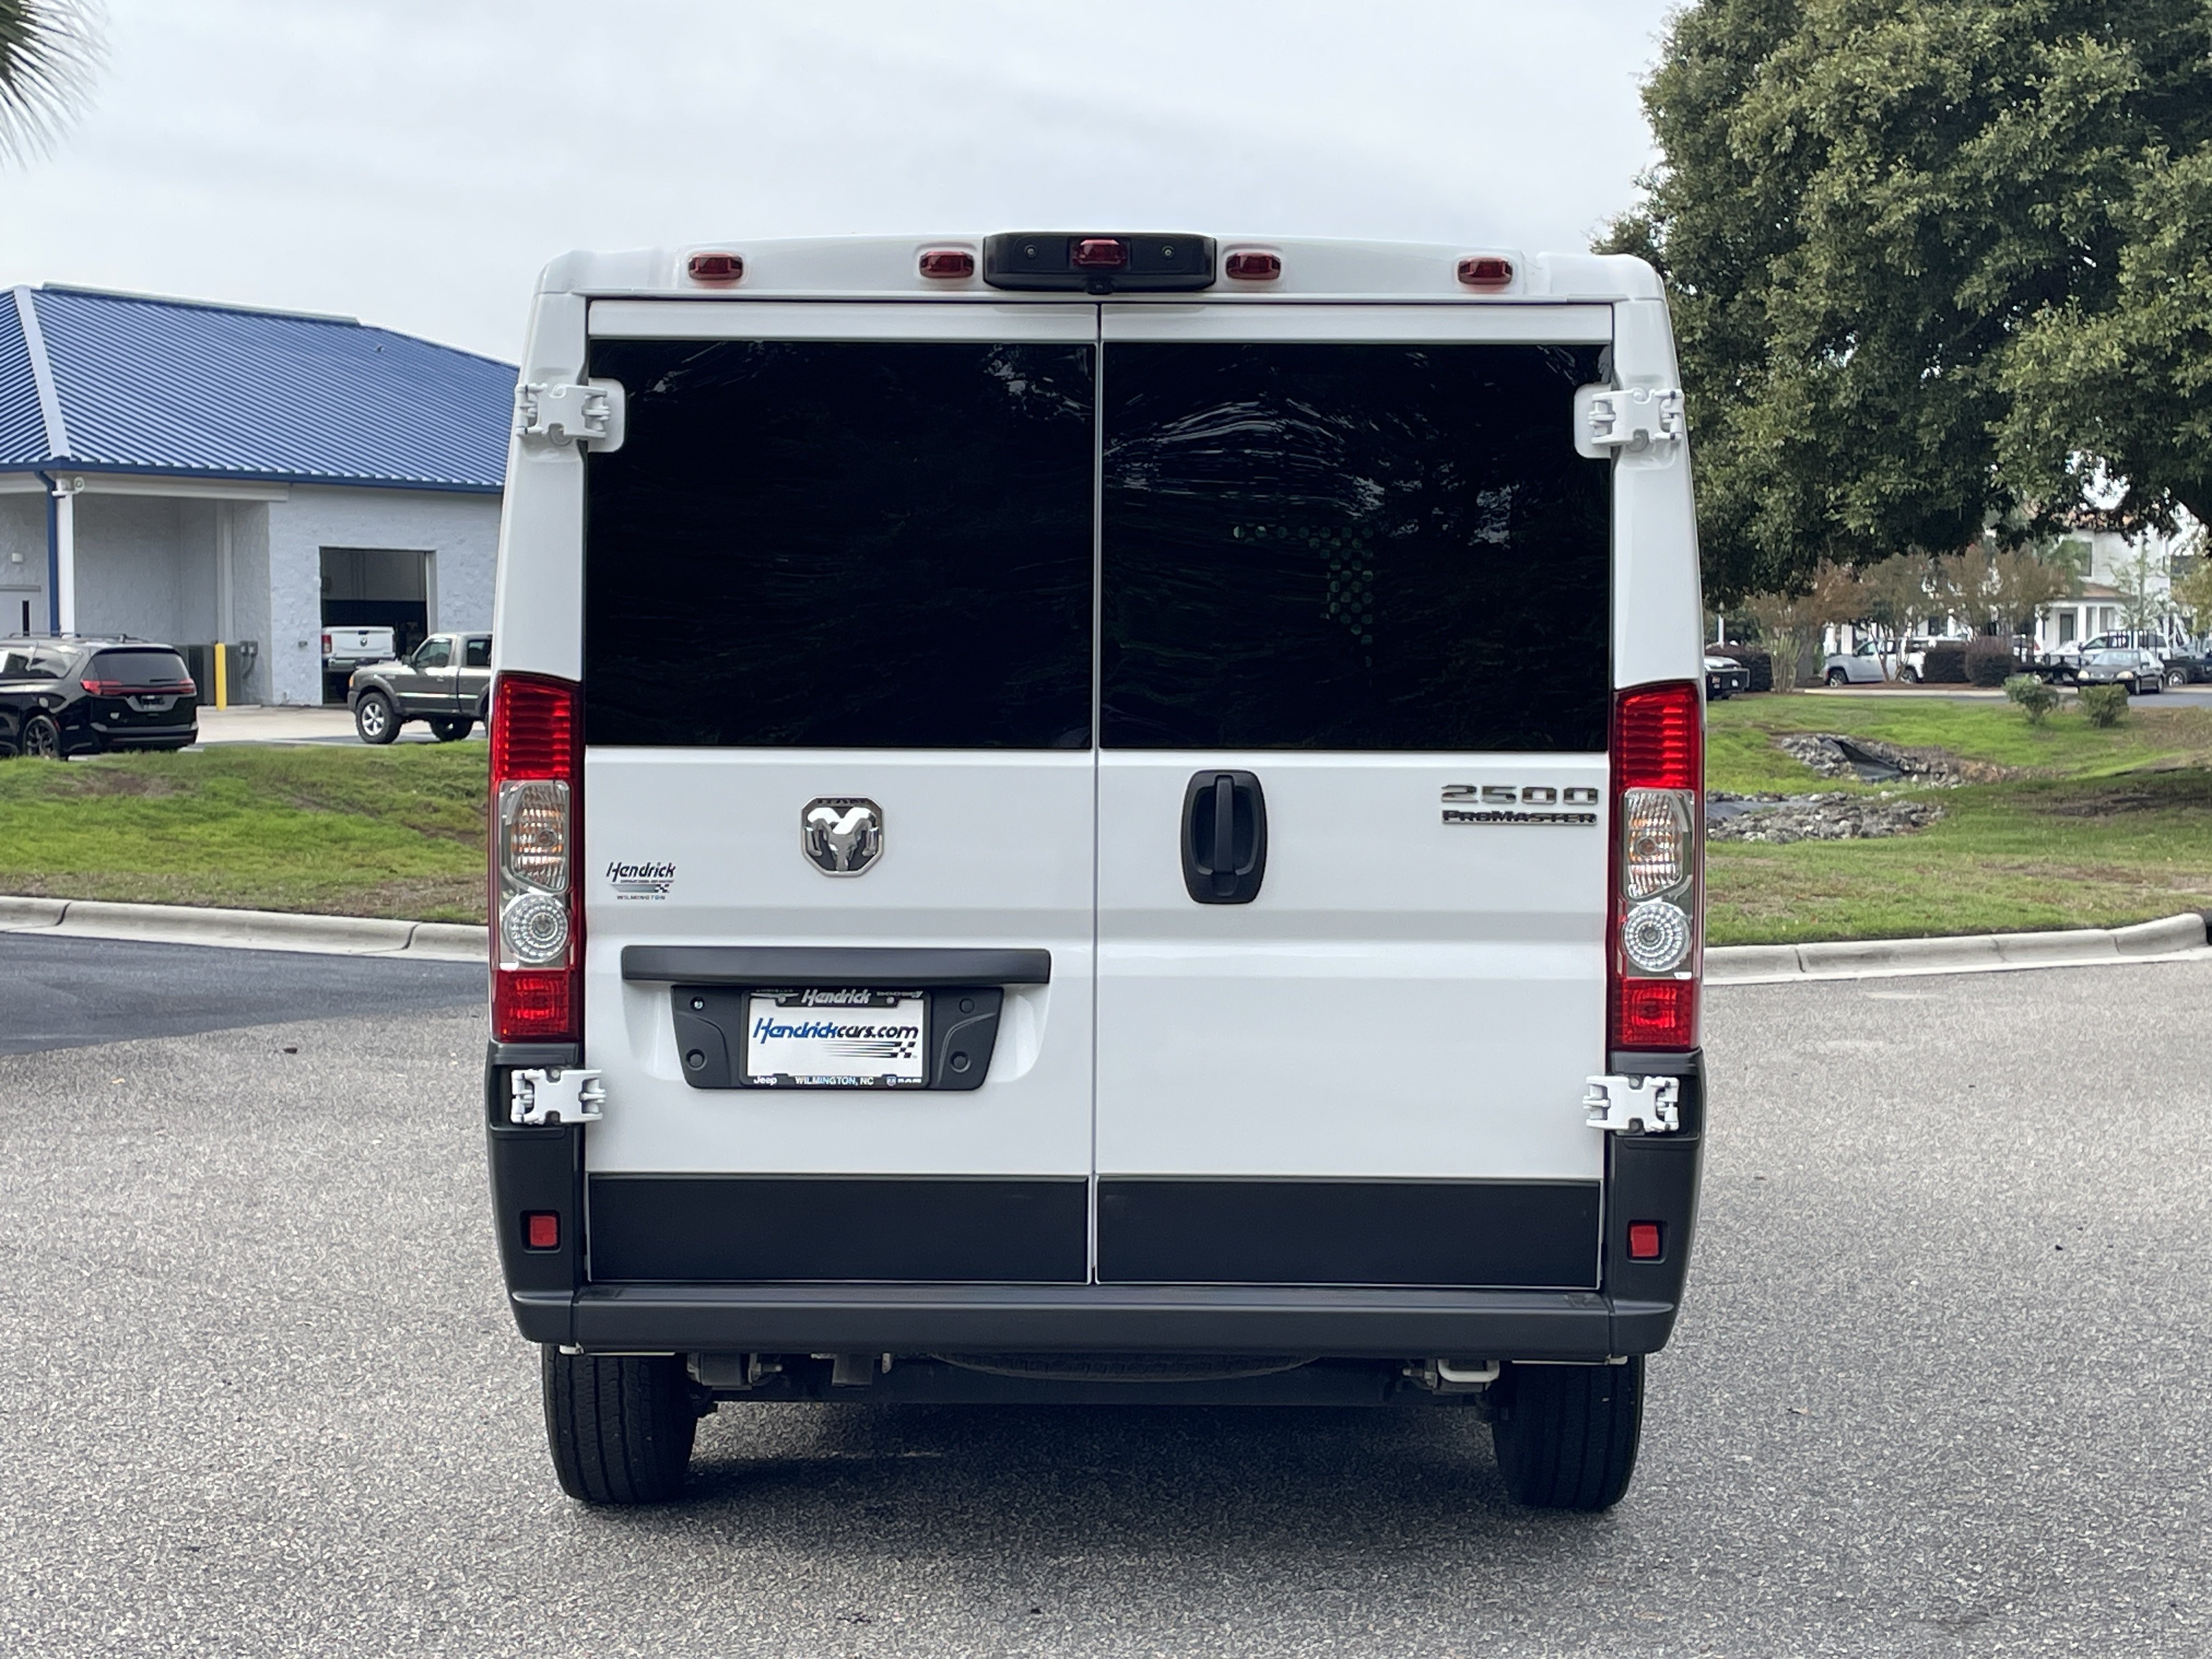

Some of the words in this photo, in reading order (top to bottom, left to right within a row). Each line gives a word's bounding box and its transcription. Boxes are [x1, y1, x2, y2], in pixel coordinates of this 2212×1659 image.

[1441, 784, 1599, 805] 2500
[606, 862, 676, 882] Hendrick
[800, 989, 872, 1007] Hendrick
[753, 1017, 919, 1044] Hendrickcars.com
[753, 1075, 778, 1086] Jeep
[795, 1075, 859, 1086] WILMINGTON,
[860, 1076, 874, 1085] NC
